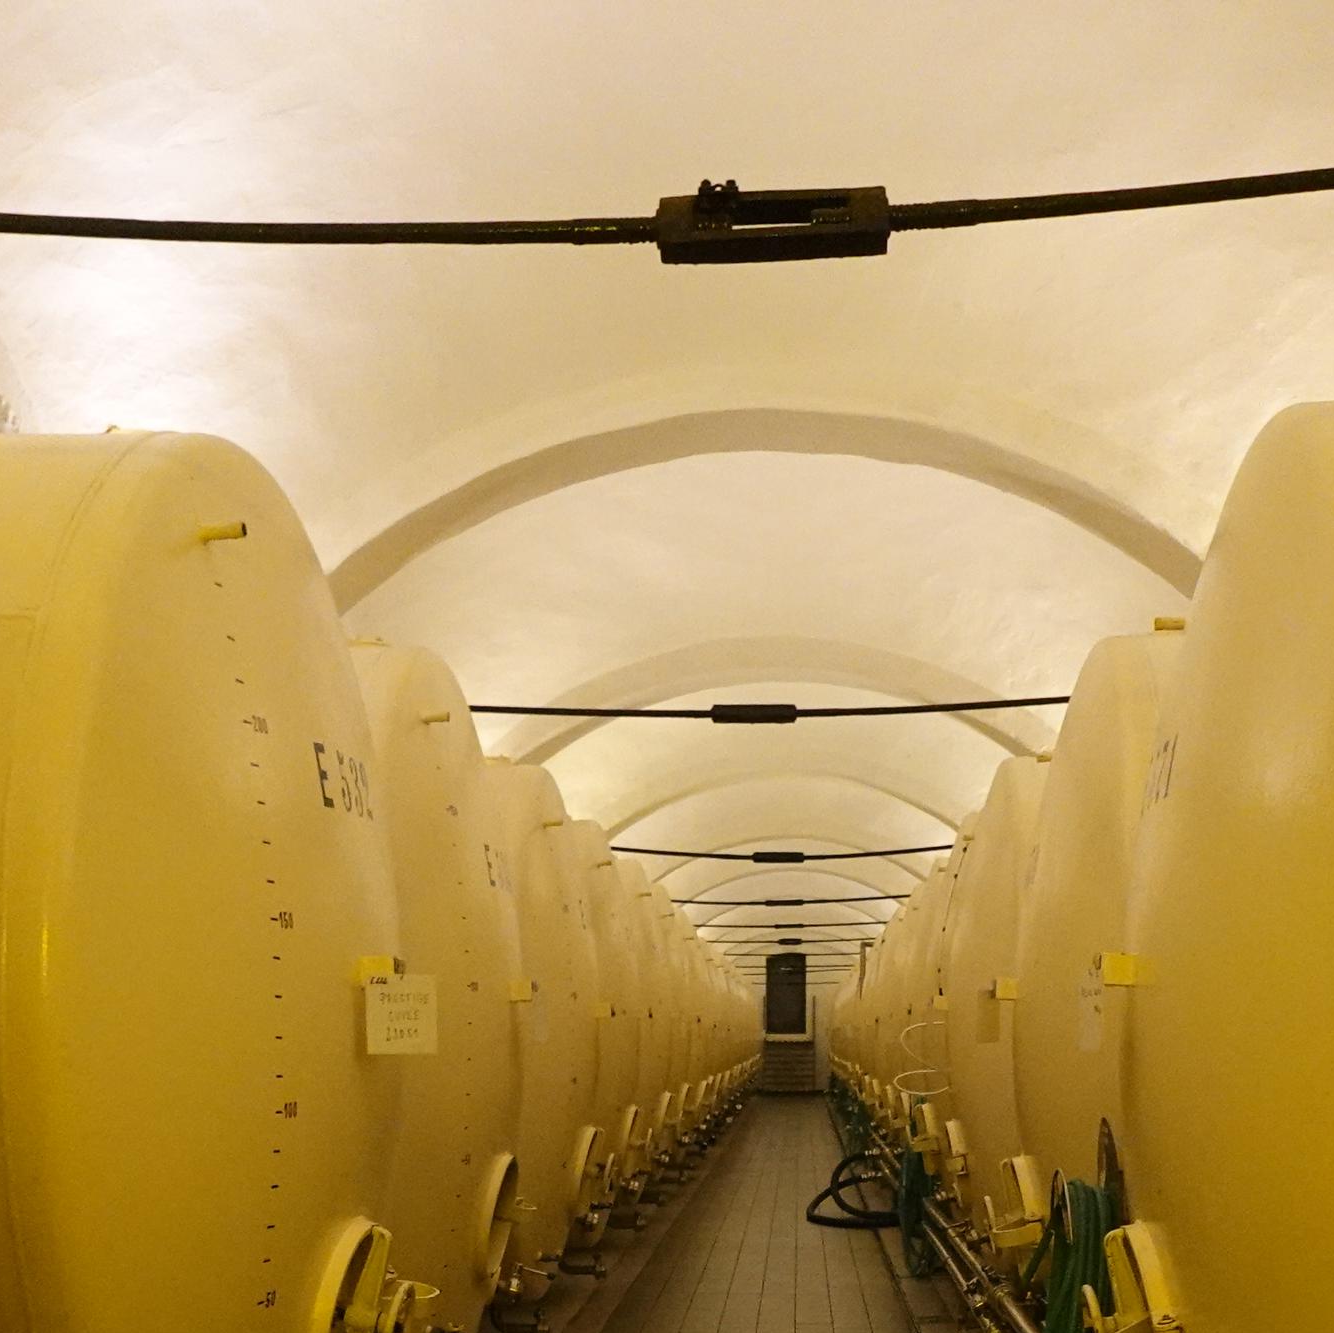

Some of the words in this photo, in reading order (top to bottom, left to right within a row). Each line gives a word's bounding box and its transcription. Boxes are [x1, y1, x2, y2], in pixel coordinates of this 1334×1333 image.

[313, 741, 335, 809] E
[278, 911, 295, 930] 150
[284, 1102, 297, 1119] 100
[265, 1290, 276, 1308] 50
